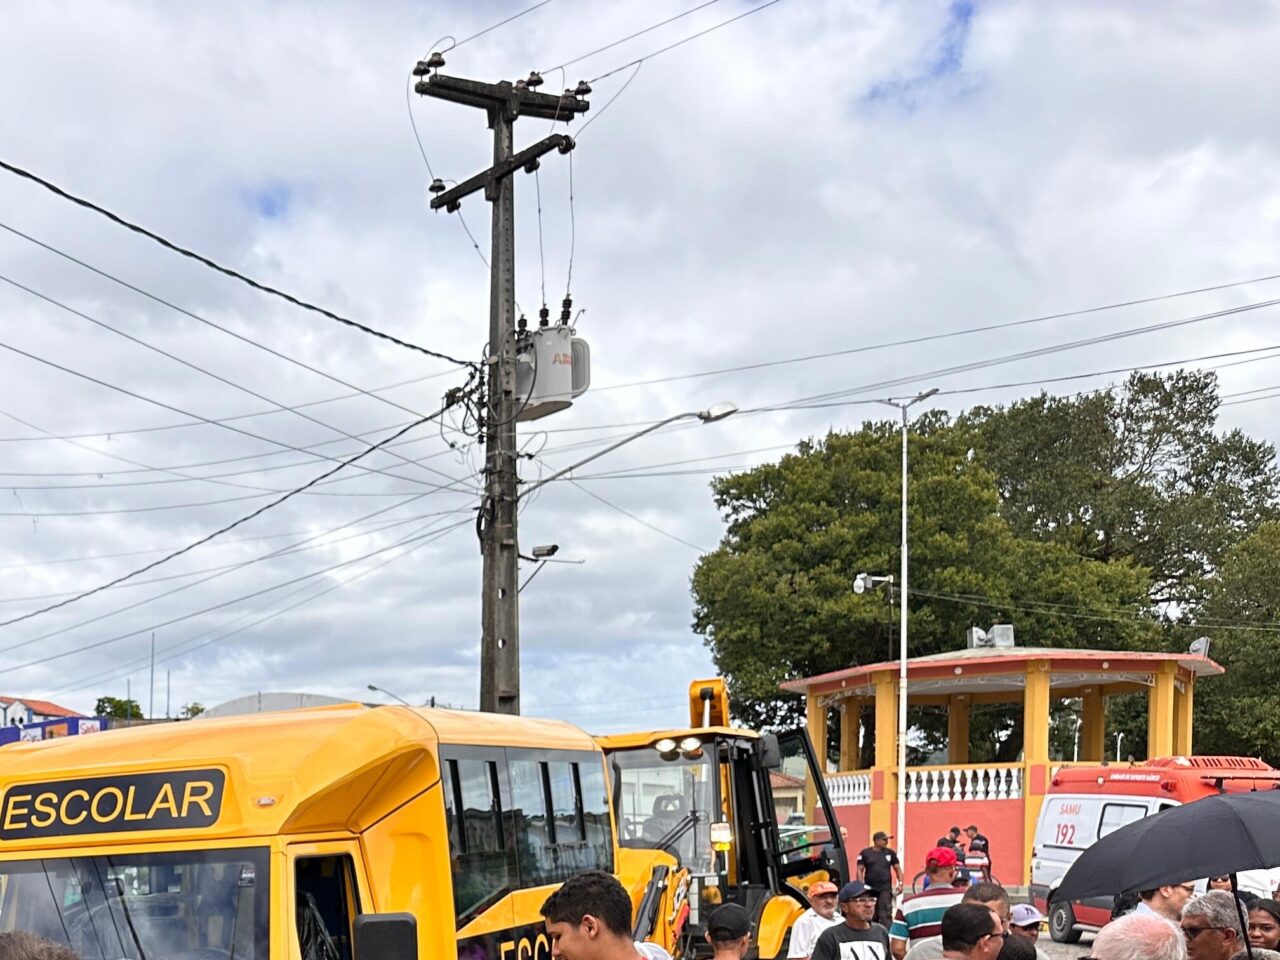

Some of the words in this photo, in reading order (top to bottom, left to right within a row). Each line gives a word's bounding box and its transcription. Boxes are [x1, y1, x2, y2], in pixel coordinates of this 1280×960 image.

[3, 780, 214, 830] ESCOLAR
[1059, 804, 1081, 816] SAMU
[1055, 823, 1076, 845] 192
